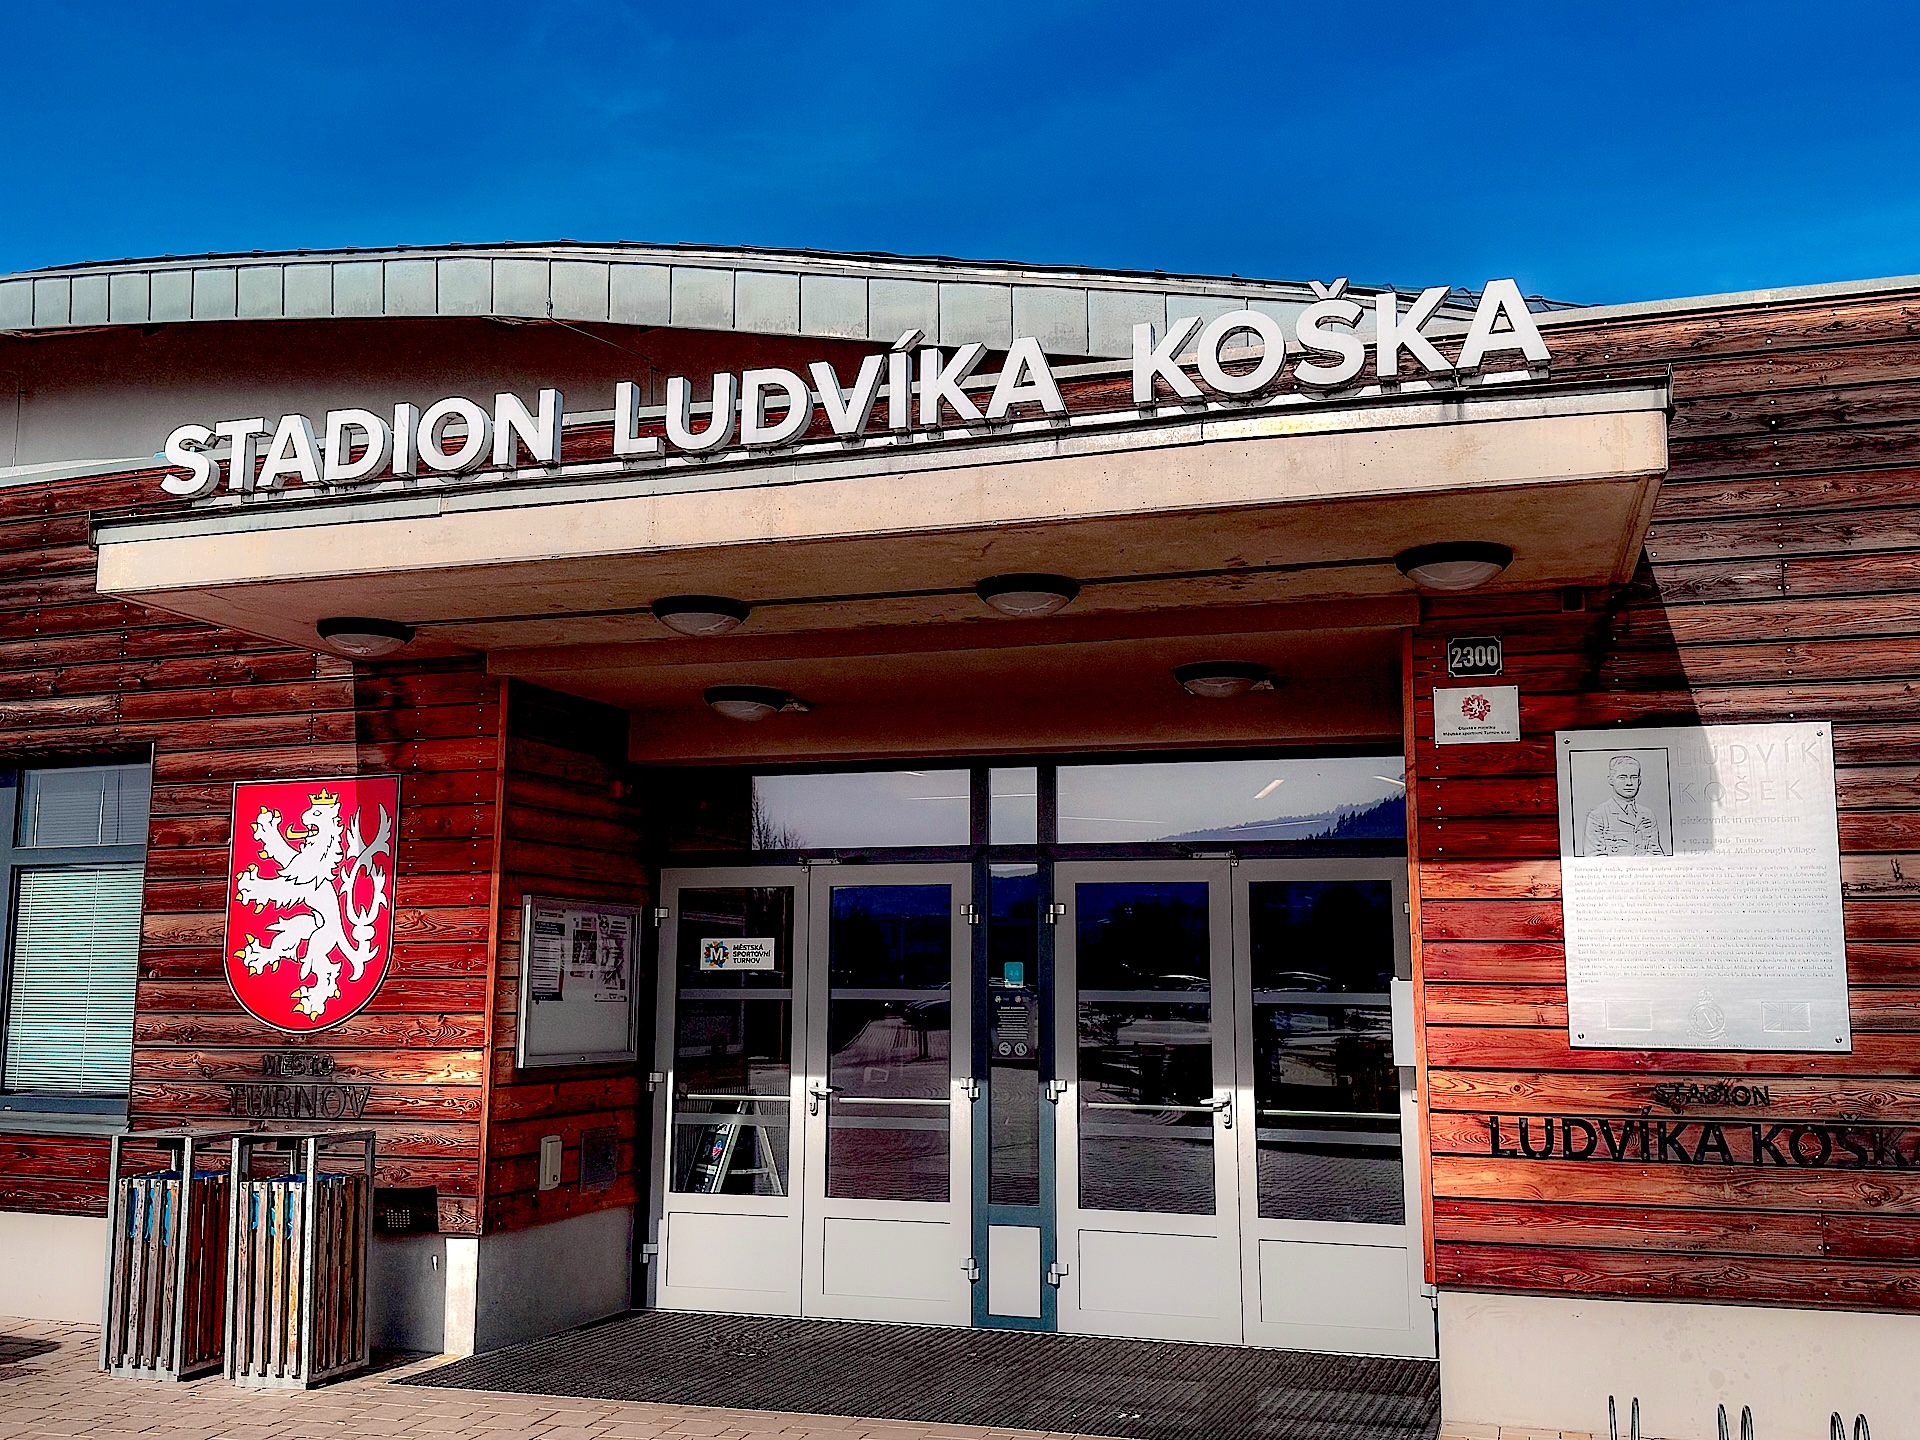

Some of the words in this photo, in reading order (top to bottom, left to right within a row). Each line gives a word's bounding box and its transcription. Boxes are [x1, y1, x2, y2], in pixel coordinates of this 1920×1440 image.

[160, 388, 563, 498] STADION
[613, 329, 1067, 454] LUDVÍKA
[1132, 276, 1551, 402] KOŠKA
[1452, 645, 1498, 668] 2300
[1677, 736, 1820, 767] LUDVÍK
[1679, 775, 1803, 803] KOŠEK
[1744, 814, 1801, 823] memoriam
[1735, 836, 1764, 845] Turnov
[1787, 846, 1817, 856] Village
[732, 943, 764, 951] MĚSTSKÁ
[732, 950, 771, 958] SPORTOVNÍ
[228, 1084, 371, 1119] TURNOV
[1655, 1083, 1770, 1107] STADION
[1489, 1106, 1734, 1166] LUDVÍKA
